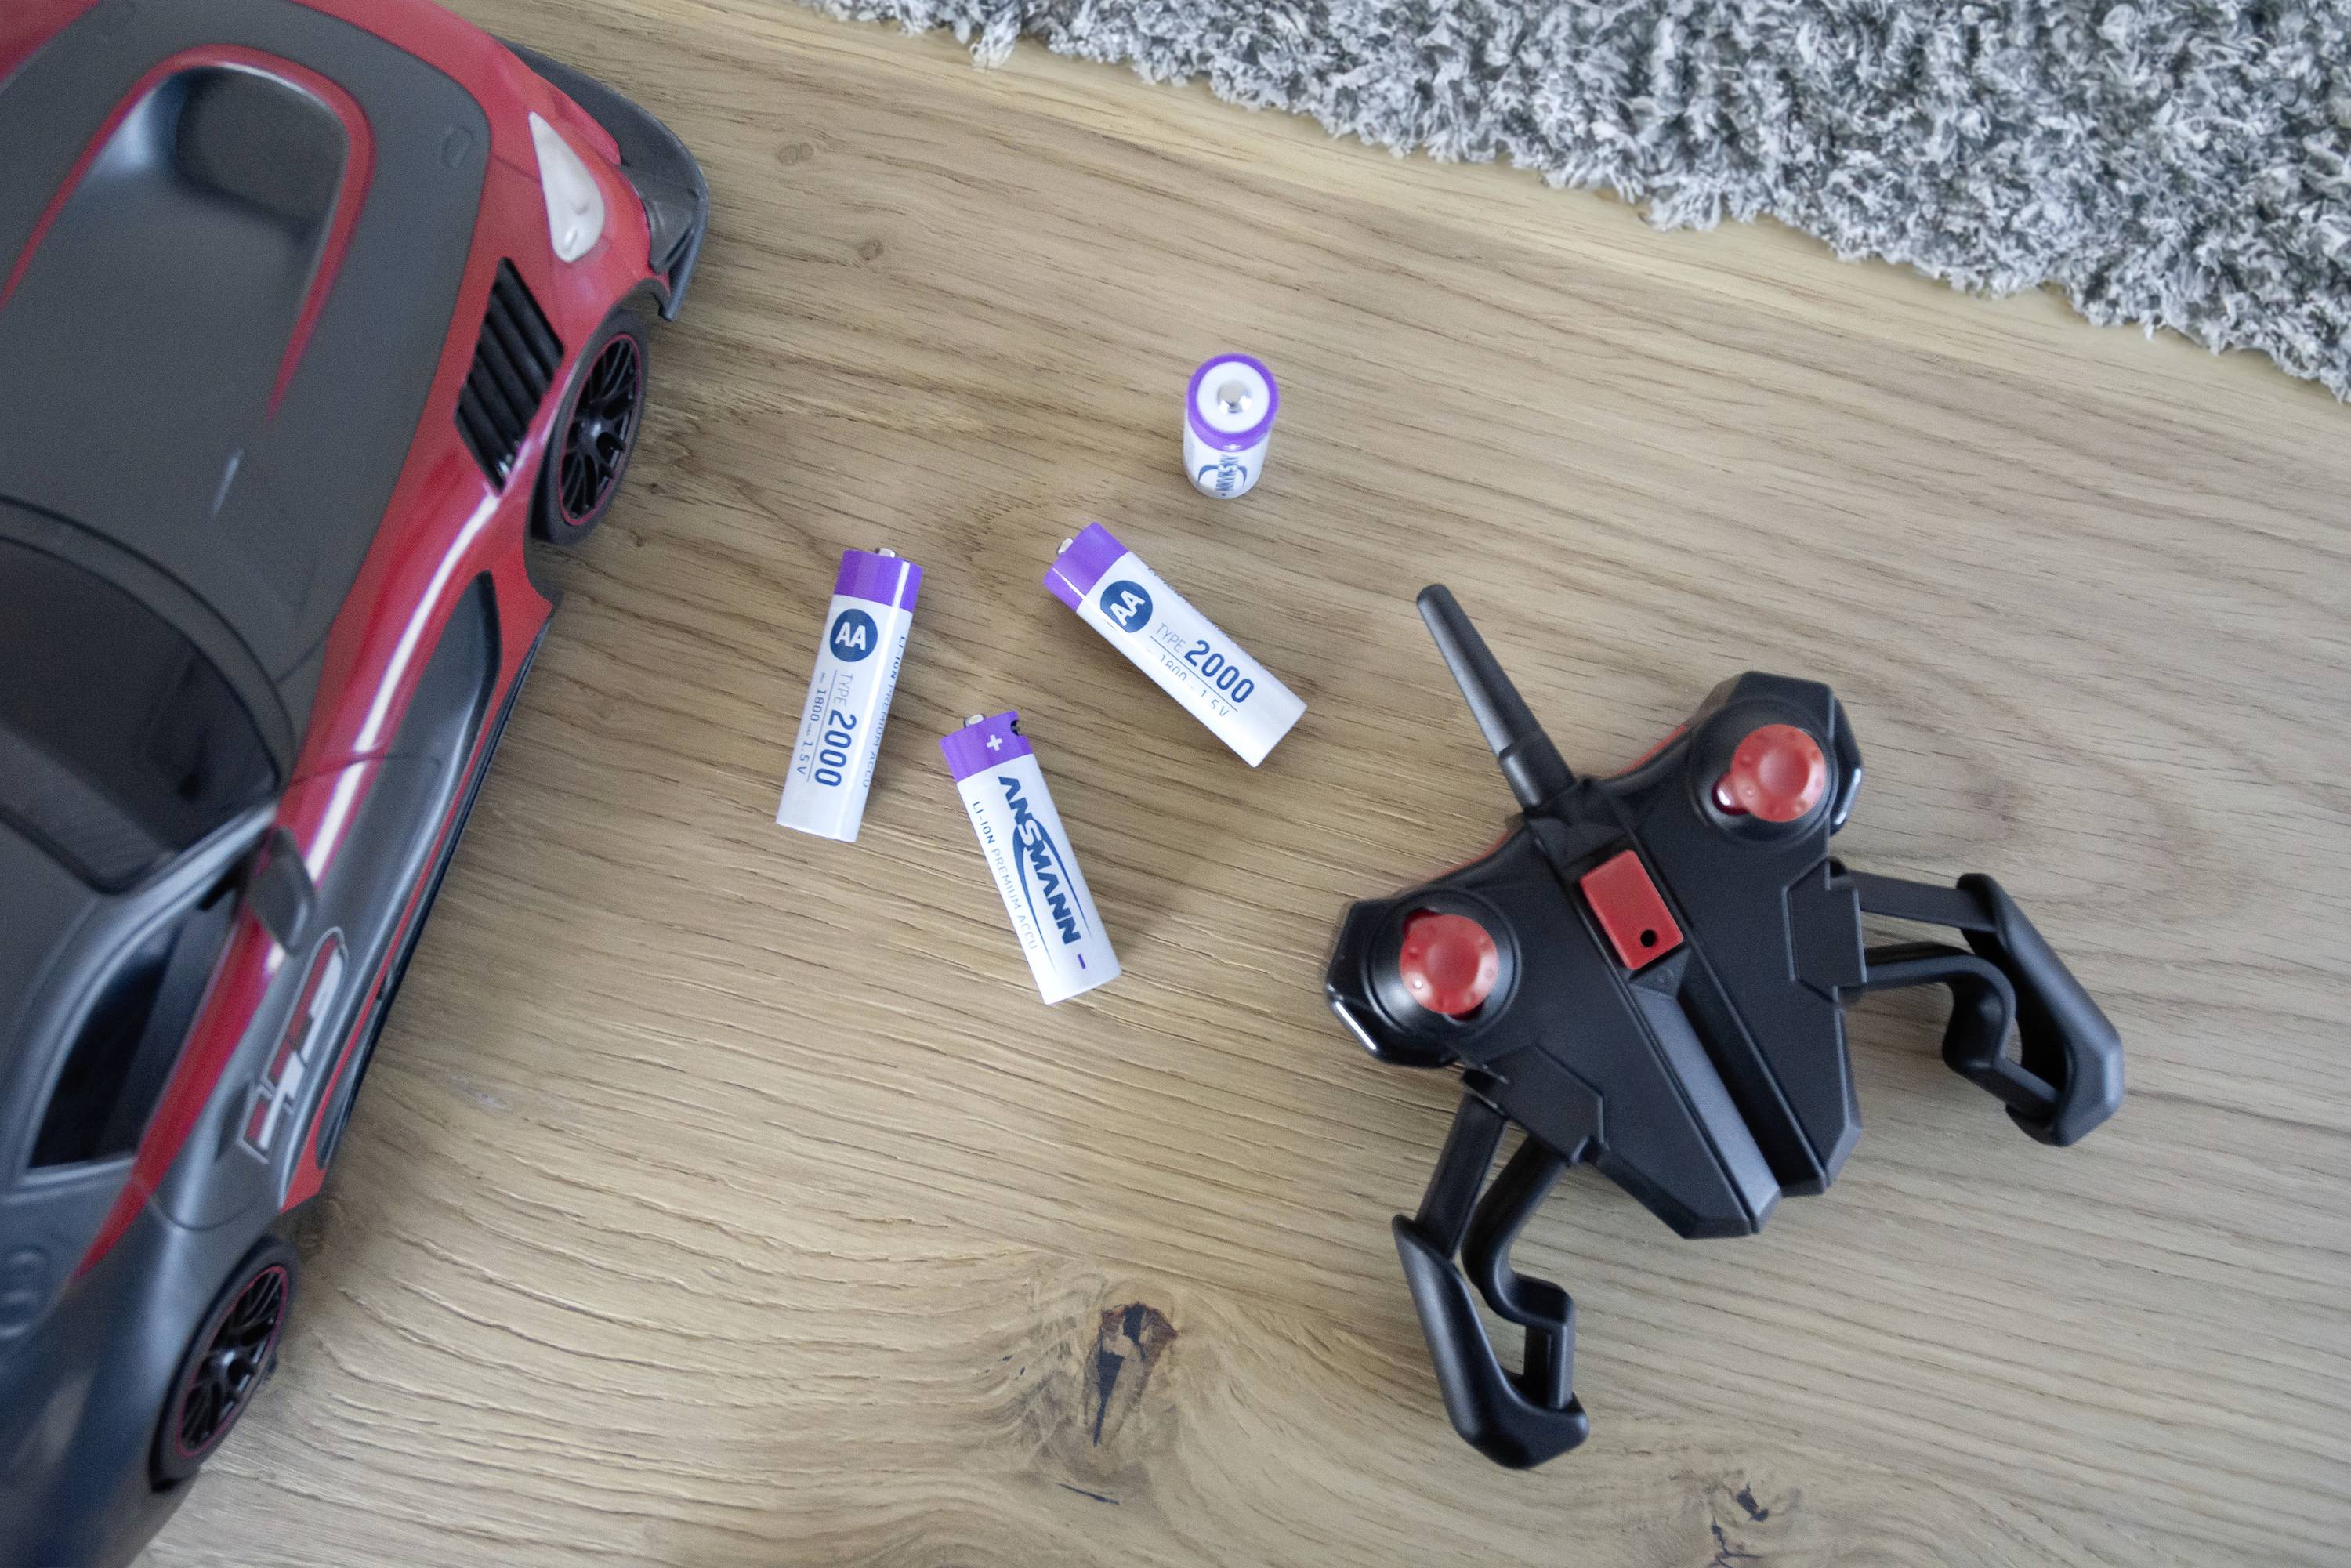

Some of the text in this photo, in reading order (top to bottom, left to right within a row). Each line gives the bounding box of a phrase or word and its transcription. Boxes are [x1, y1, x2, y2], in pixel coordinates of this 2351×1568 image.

[835, 622, 866, 650] AA
[1110, 591, 1146, 627] AA
[1156, 623, 1255, 704] TYPE 2000
[810, 689, 827, 722] 1800
[814, 673, 857, 787] TYPE 2000
[973, 801, 1038, 950] LI-ION PREMIUM ACCU
[998, 777, 1081, 945] ANSMANN
